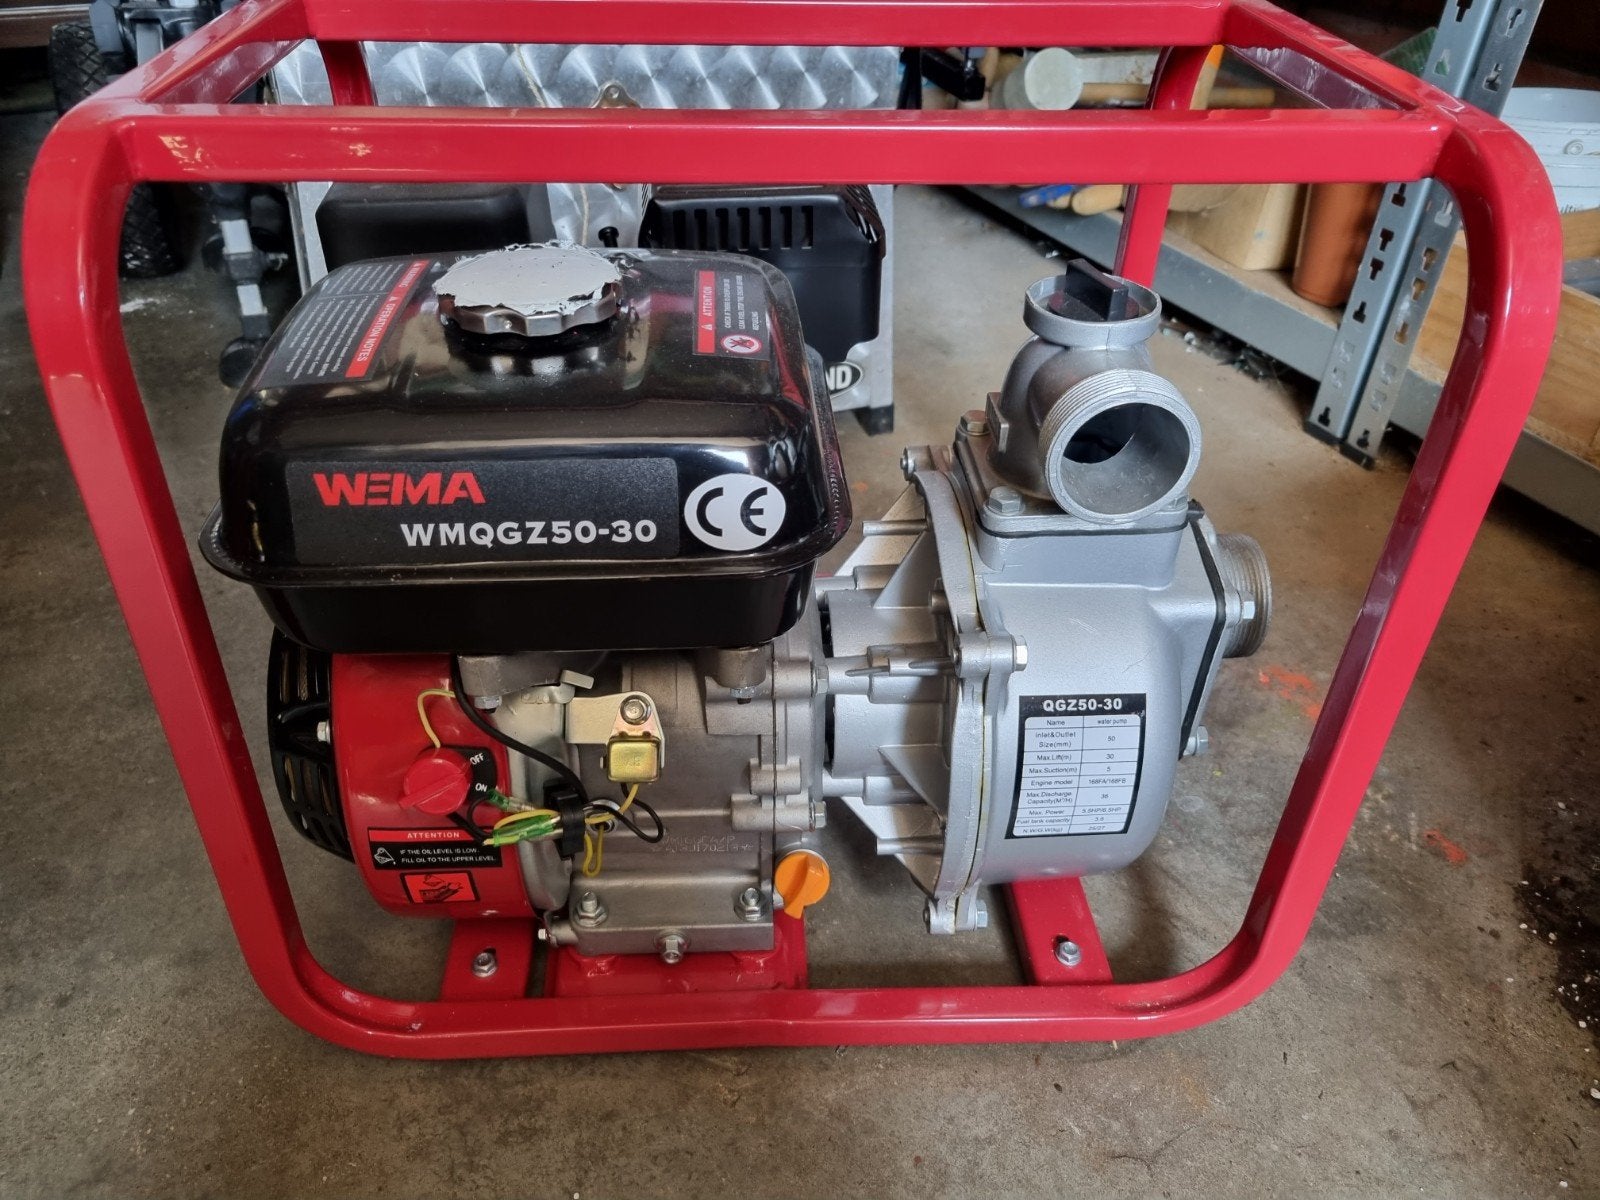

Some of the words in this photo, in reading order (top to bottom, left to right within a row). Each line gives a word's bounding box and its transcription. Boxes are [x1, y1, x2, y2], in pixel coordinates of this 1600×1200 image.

[703, 286, 713, 316] ATTENTION
[369, 304, 396, 337] OPERATION
[357, 338, 377, 361] NOTES
[696, 486, 767, 537] CE
[401, 519, 658, 548] WMQGZ50-30
[1042, 698, 1123, 712] QGZ50-30
[1112, 718, 1128, 726] pump
[470, 753, 484, 765] OFF
[475, 783, 487, 792] ON
